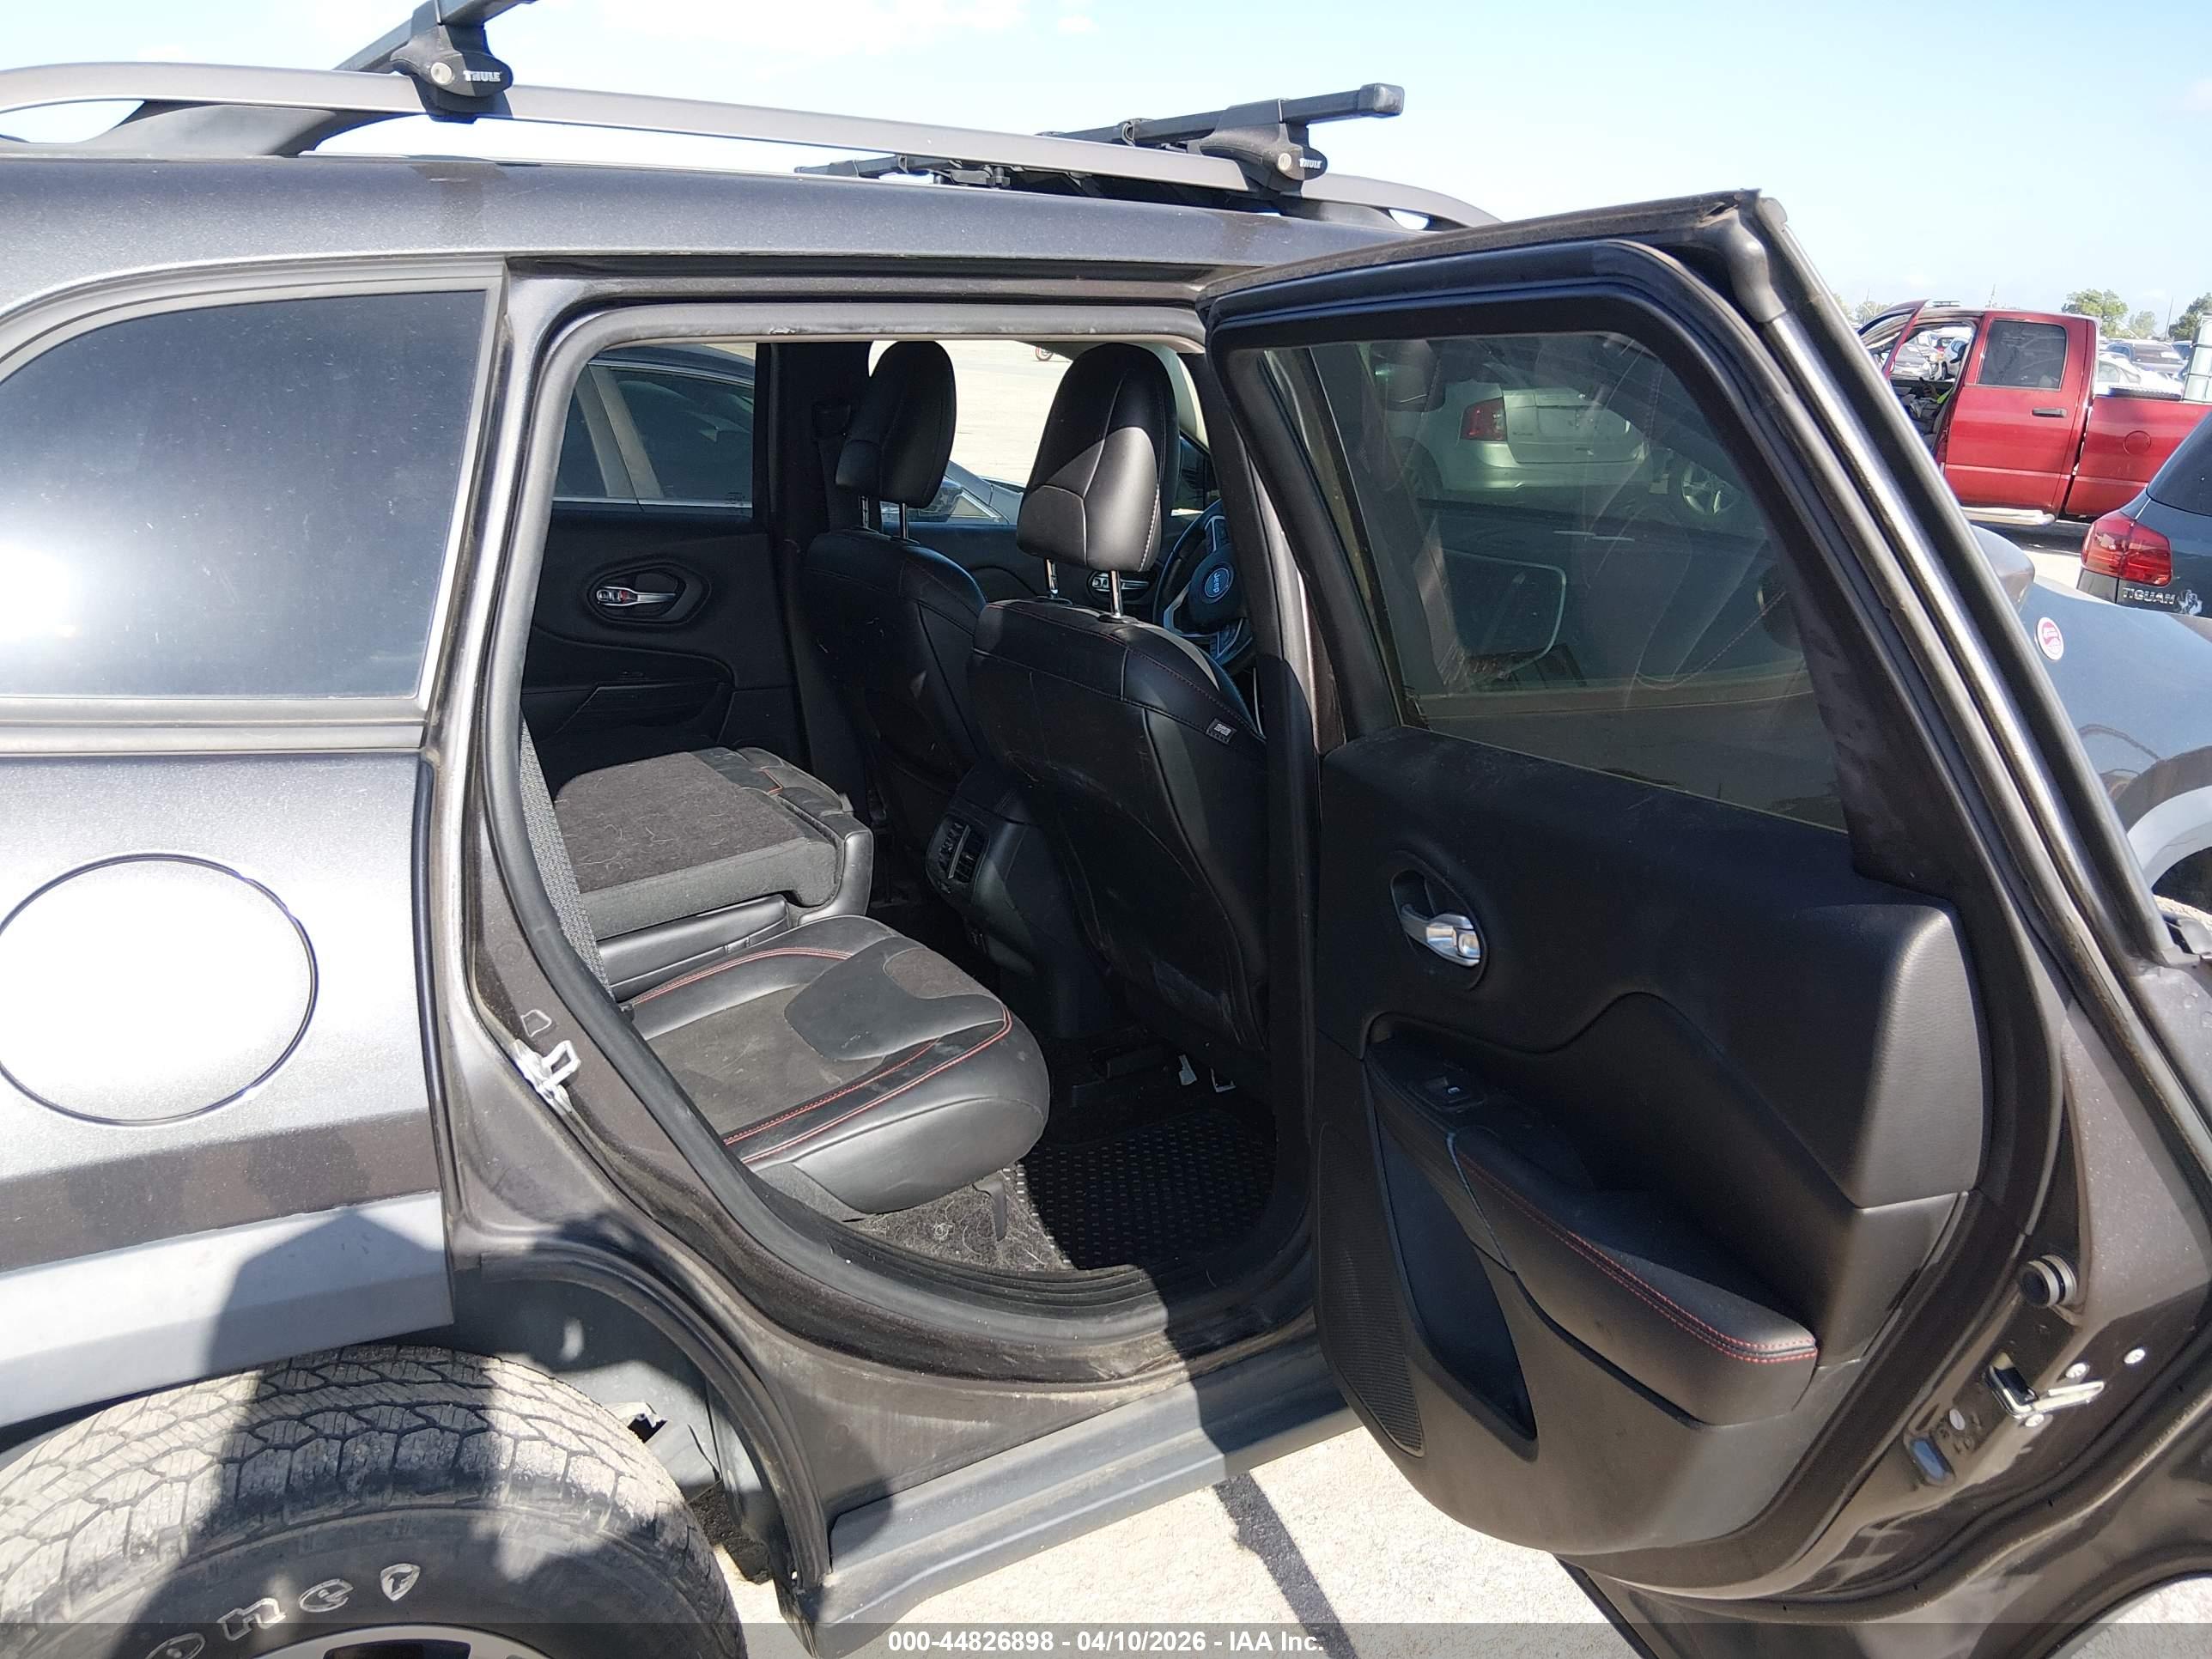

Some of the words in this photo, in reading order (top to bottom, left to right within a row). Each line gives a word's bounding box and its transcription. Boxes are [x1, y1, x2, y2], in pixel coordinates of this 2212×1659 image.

[463, 70, 501, 82] THULE
[1298, 157, 1322, 168] THULE
[1212, 572, 1221, 592] Jeep
[2122, 587, 2176, 605] TIGUAN
